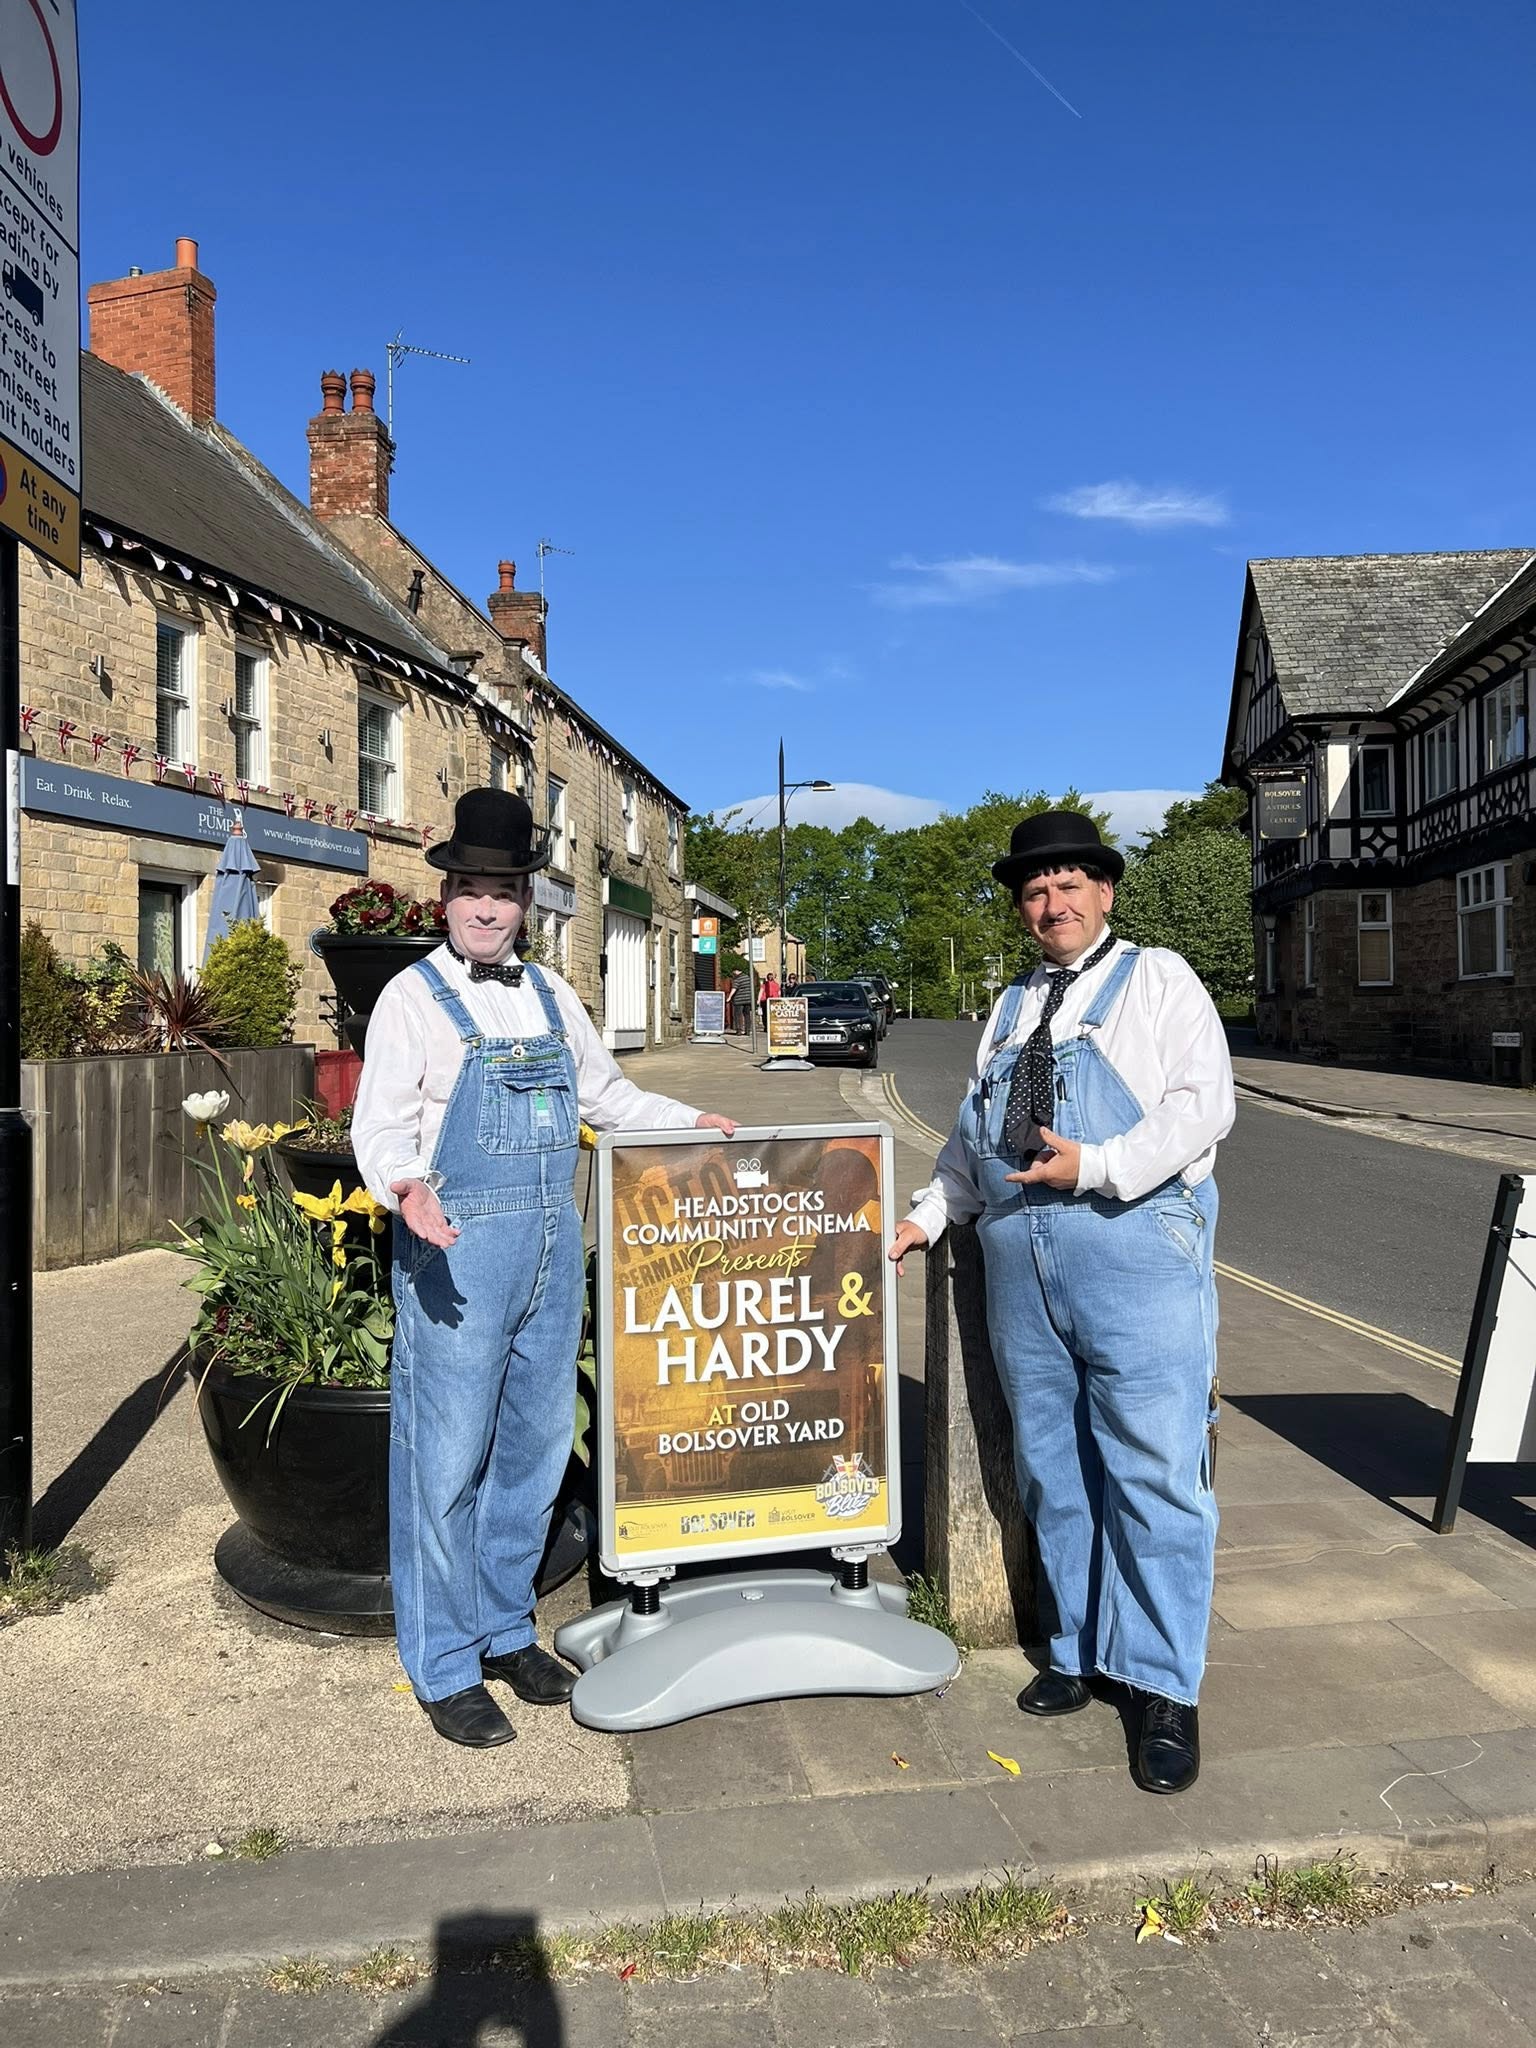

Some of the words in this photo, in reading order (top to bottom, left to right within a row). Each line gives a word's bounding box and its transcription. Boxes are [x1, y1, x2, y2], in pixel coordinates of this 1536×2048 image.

[8, 142, 63, 222] vehicles
[0, 189, 36, 243] cept
[40, 230, 59, 266] for
[0, 222, 39, 281] ading
[43, 262, 60, 300] by
[0, 302, 38, 352] ccess
[41, 339, 57, 369] to
[0, 328, 58, 402] f-street
[0, 368, 40, 417] mises
[44, 407, 70, 443] and
[21, 411, 75, 476] holders
[20, 468, 38, 499] At
[42, 493, 67, 523] any
[27, 505, 59, 544] time
[36, 778, 57, 793] Eat.
[64, 784, 96, 801] Drink.
[102, 792, 133, 809] Relax.
[1264, 790, 1301, 798] BOLSOVER
[1265, 803, 1301, 811] ANTIQUES
[198, 813, 234, 832] PUMP
[208, 805, 225, 816] THE
[263, 828, 361, 856] www.thepumpbolsover.co.uk
[776, 1010, 800, 1018] CASTLE
[673, 1190, 825, 1220] HEADSTOCKS
[622, 1216, 780, 1246] COMMUNITY
[782, 1213, 872, 1237] CINEMA
[687, 1235, 816, 1286] Presents
[623, 1275, 825, 1334] LAUREL
[837, 1271, 875, 1318] &
[655, 1324, 848, 1386] HARDY
[707, 1404, 737, 1427] AT
[740, 1399, 790, 1423] OLD
[658, 1426, 780, 1455] BOLSOVER
[785, 1418, 845, 1443] YARD
[816, 1477, 880, 1502] BOLSOVER
[826, 1493, 871, 1517] Blitz
[681, 1509, 755, 1534] BOLSOVER
[781, 1513, 816, 1521] BOLSOVER
